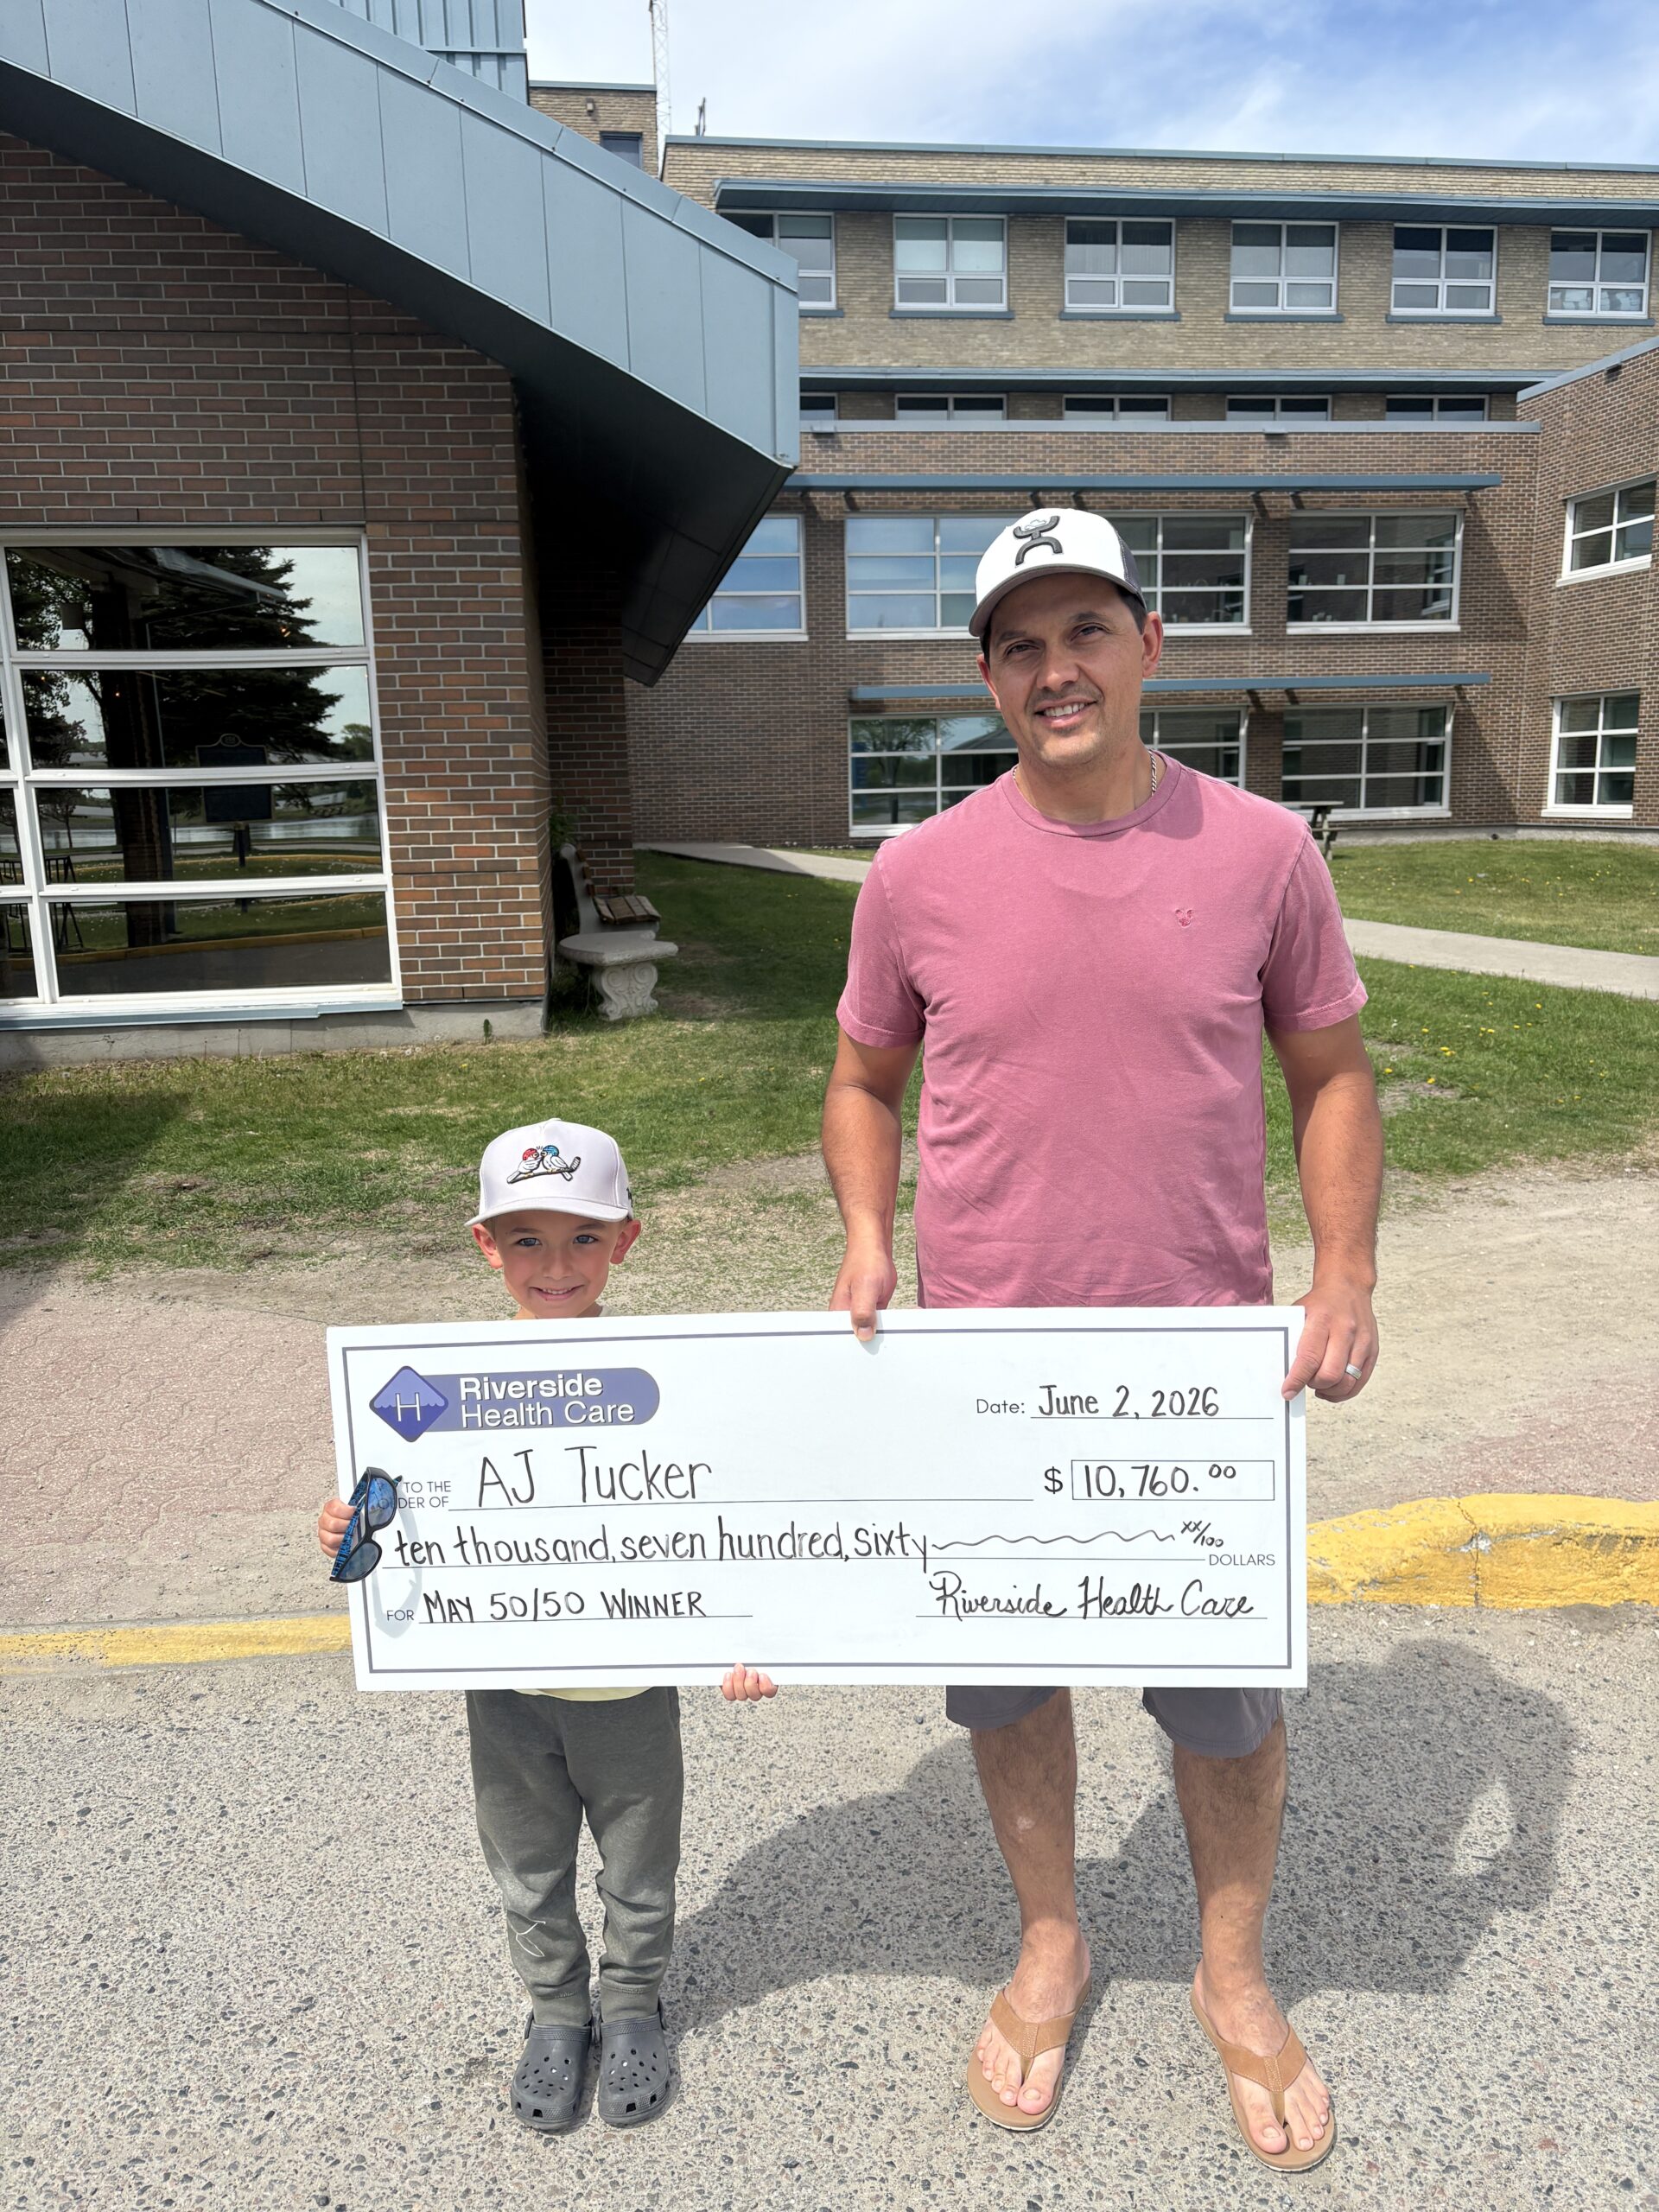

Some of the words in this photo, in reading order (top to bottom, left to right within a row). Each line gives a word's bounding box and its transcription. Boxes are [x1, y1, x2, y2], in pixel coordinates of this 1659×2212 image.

[460, 1373, 604, 1401] Riverside
[976, 1398, 1026, 1414] Date:
[1039, 1384, 1099, 1415] June
[1112, 1385, 1140, 1419] 2,
[1151, 1387, 1219, 1417] 2026
[396, 1392, 422, 1422] H
[461, 1402, 553, 1428] Health
[564, 1401, 635, 1424] Care
[378, 1497, 425, 1510] ODER
[429, 1496, 449, 1508] OF
[478, 1448, 535, 1508] AJ
[564, 1446, 712, 1503] Tucker
[404, 1481, 423, 1493] TO
[427, 1480, 452, 1493] THE
[1044, 1465, 1064, 1495] $
[395, 1530, 446, 1566] ten
[1209, 1554, 1276, 1567] DOLLARS
[387, 1610, 415, 1622] FOR
[423, 1589, 475, 1624] MAY
[490, 1587, 586, 1622] 50/50
[601, 1587, 708, 1620] WINNER
[929, 1570, 1068, 1622] Riverside
[1077, 1575, 1174, 1620] Health
[1180, 1579, 1254, 1618] Care
